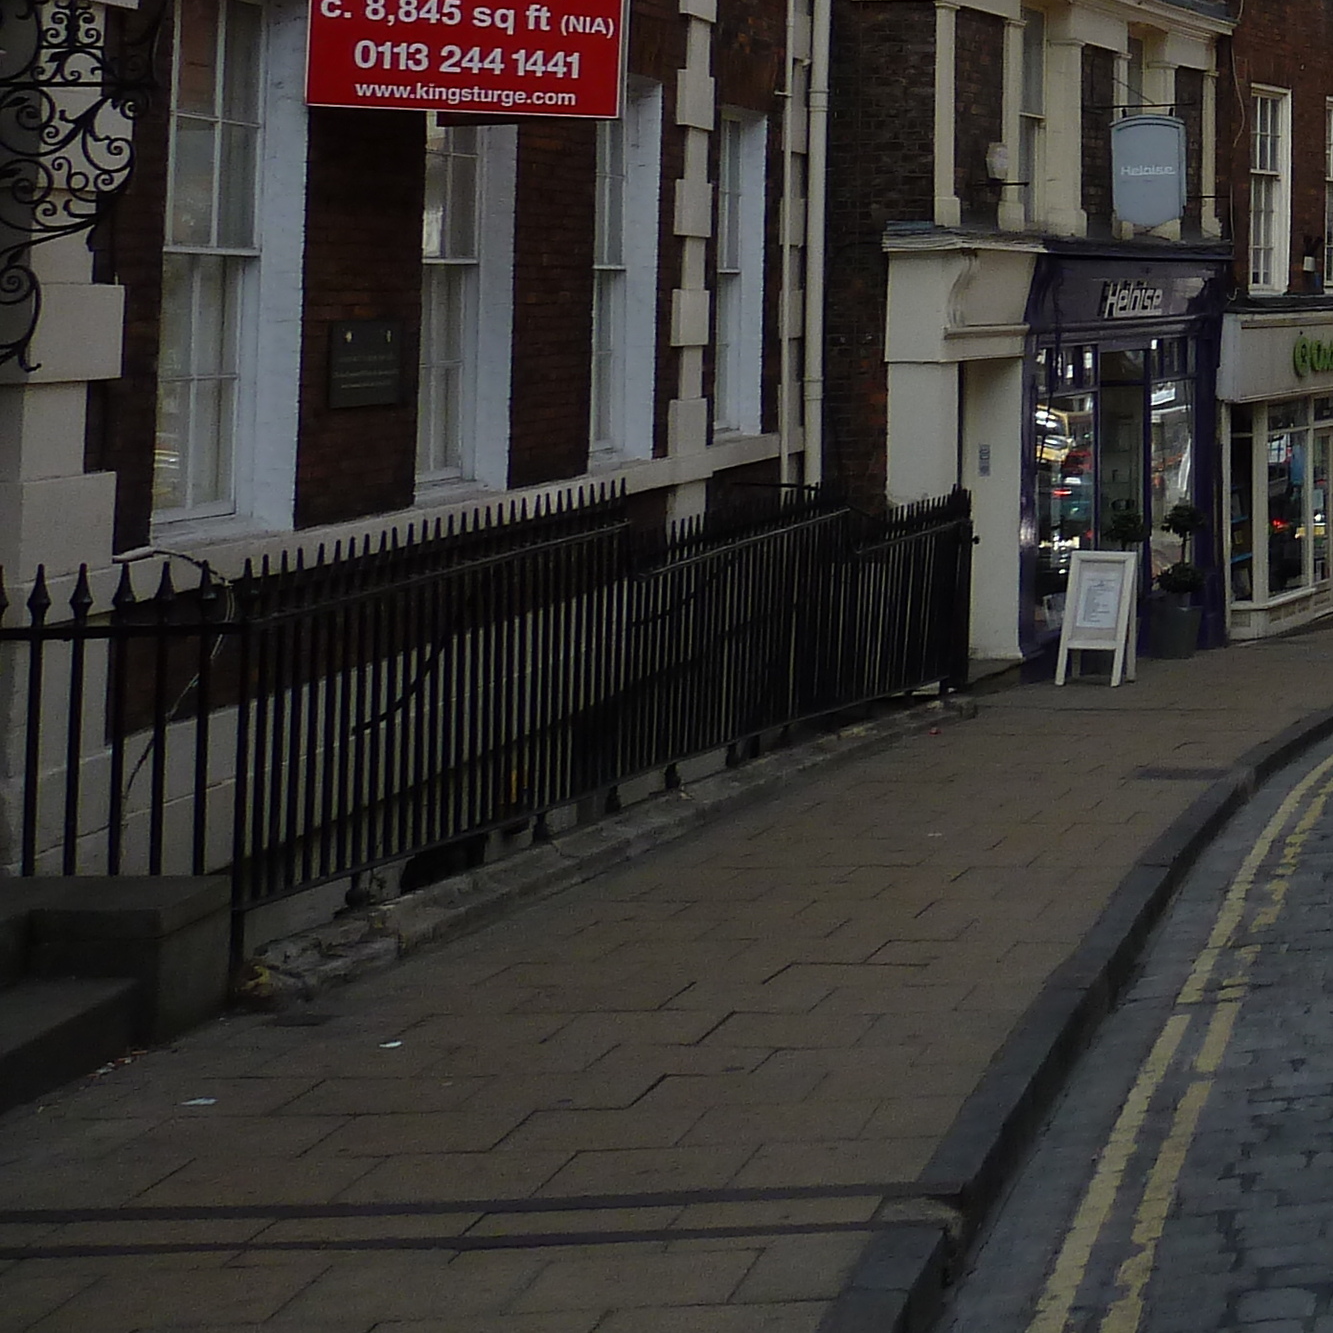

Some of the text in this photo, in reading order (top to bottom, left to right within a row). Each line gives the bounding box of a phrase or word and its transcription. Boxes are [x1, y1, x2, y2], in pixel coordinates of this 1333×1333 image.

[472, 7, 515, 35] sq
[525, 5, 551, 31] ft
[560, 15, 614, 39] (NIA)
[354, 40, 580, 78] 0113 244 1441
[354, 82, 576, 106] www.kingsturge.com
